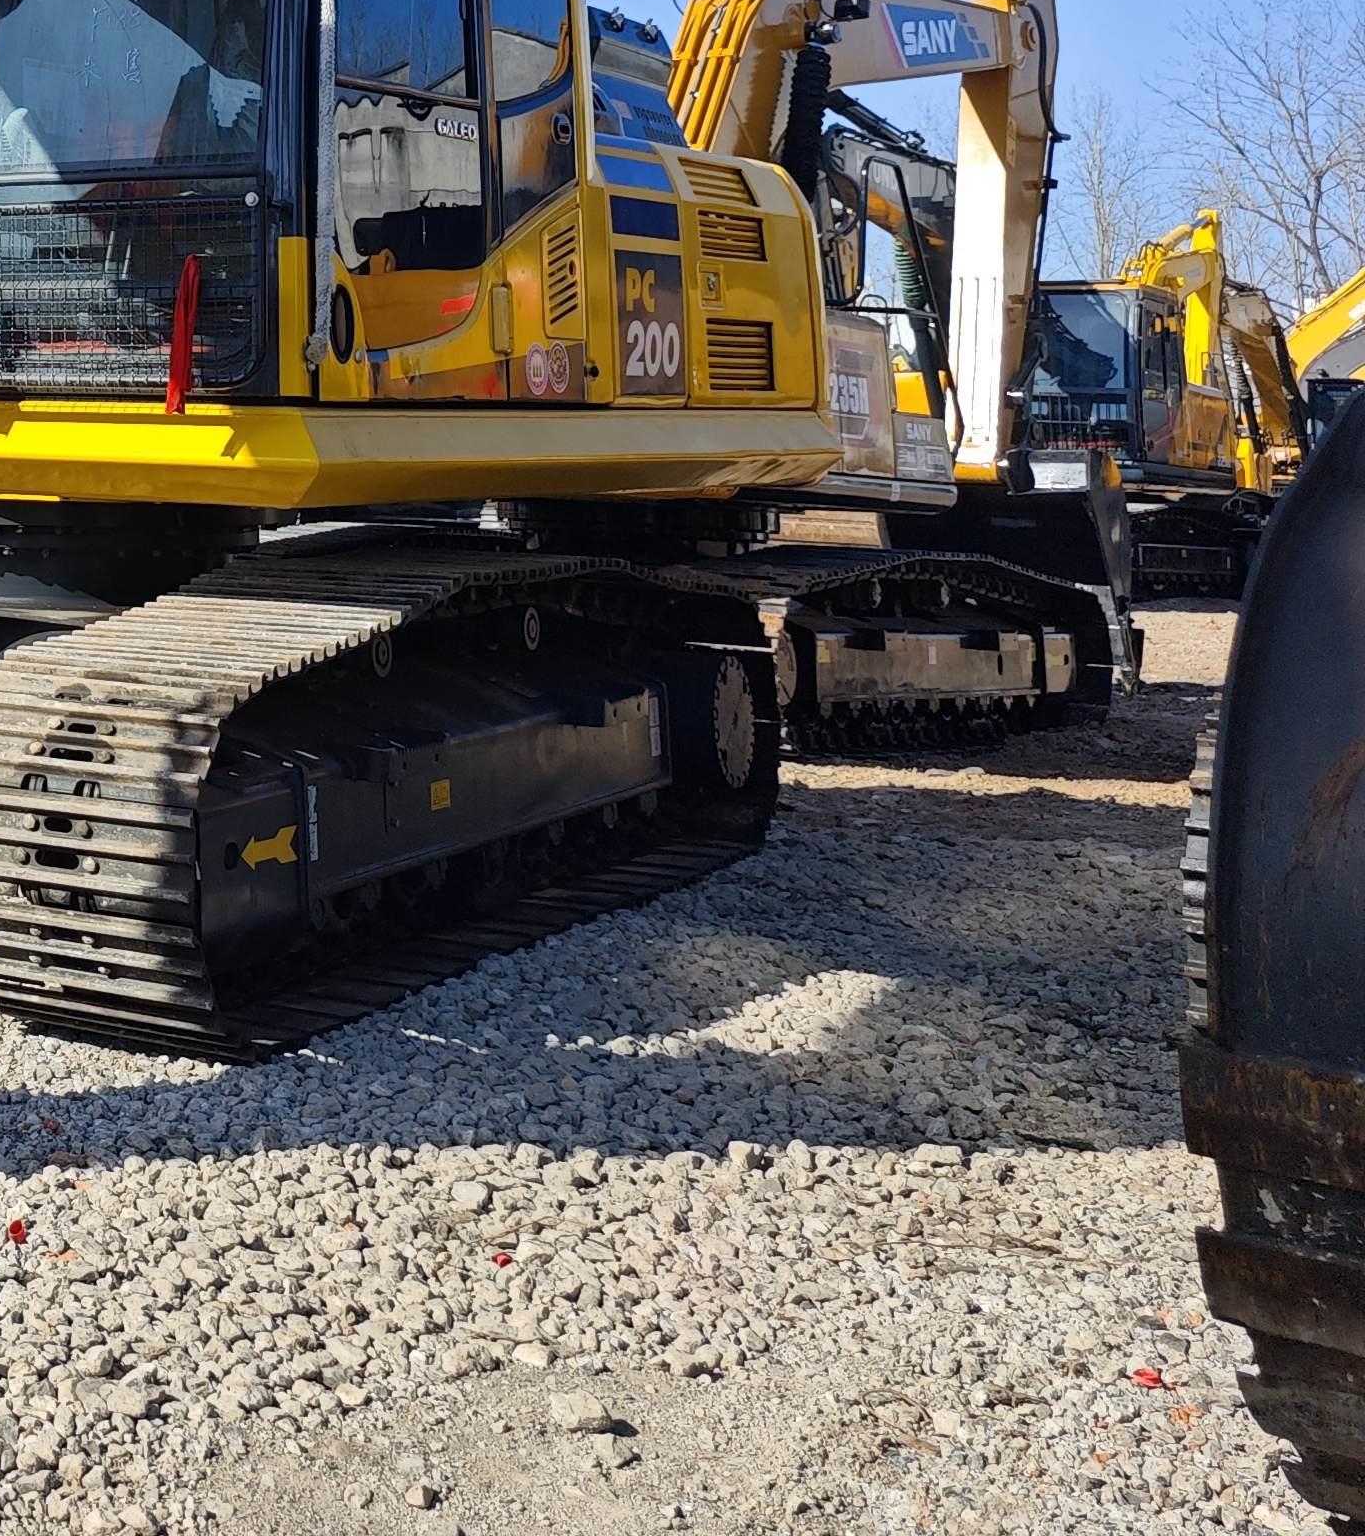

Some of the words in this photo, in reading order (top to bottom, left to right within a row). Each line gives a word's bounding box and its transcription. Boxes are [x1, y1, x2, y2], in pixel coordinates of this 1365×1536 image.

[901, 19, 957, 56] SANY
[437, 117, 477, 141] GALEO
[626, 267, 655, 312] PC
[625, 319, 681, 378] 200
